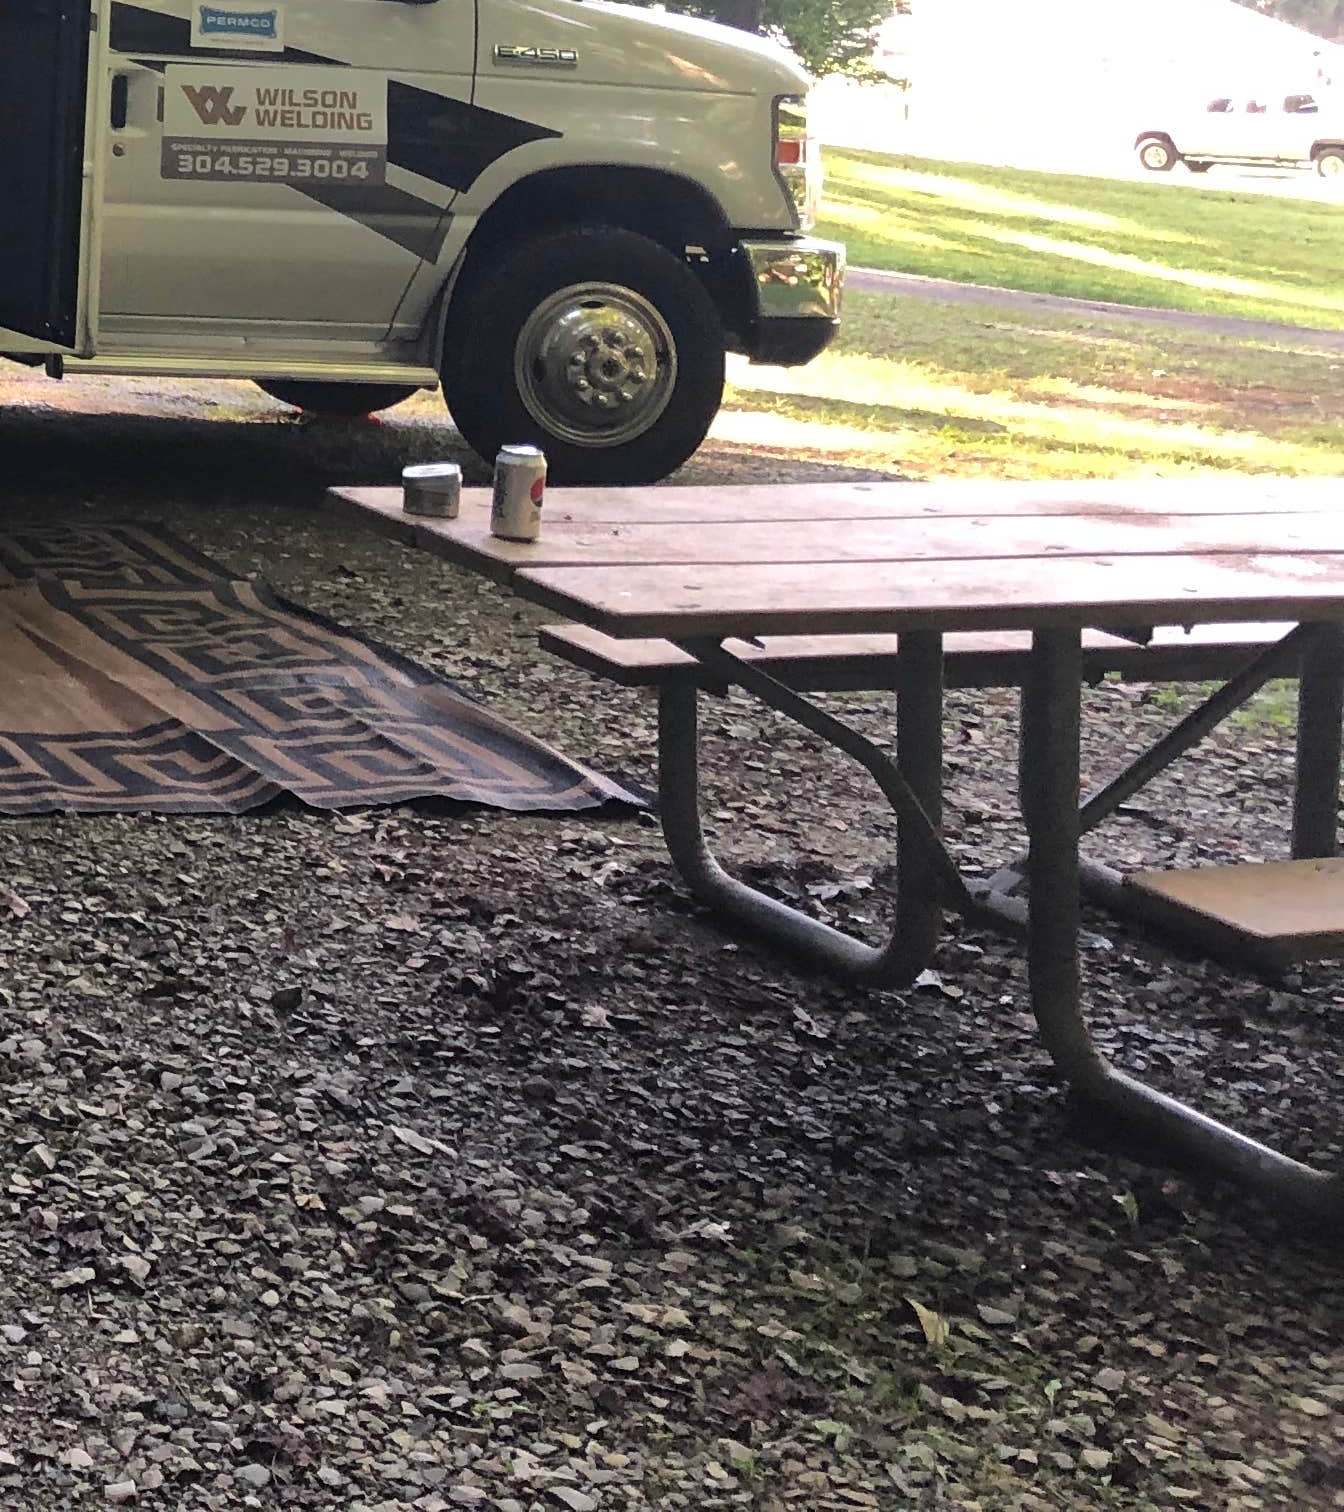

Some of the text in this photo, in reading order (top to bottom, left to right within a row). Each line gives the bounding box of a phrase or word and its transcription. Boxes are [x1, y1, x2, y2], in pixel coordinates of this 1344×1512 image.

[206, 15, 272, 29] PERMCO
[255, 87, 358, 110] WILSON
[254, 109, 373, 131] WELDING
[177, 154, 370, 179] 304.529.3004
